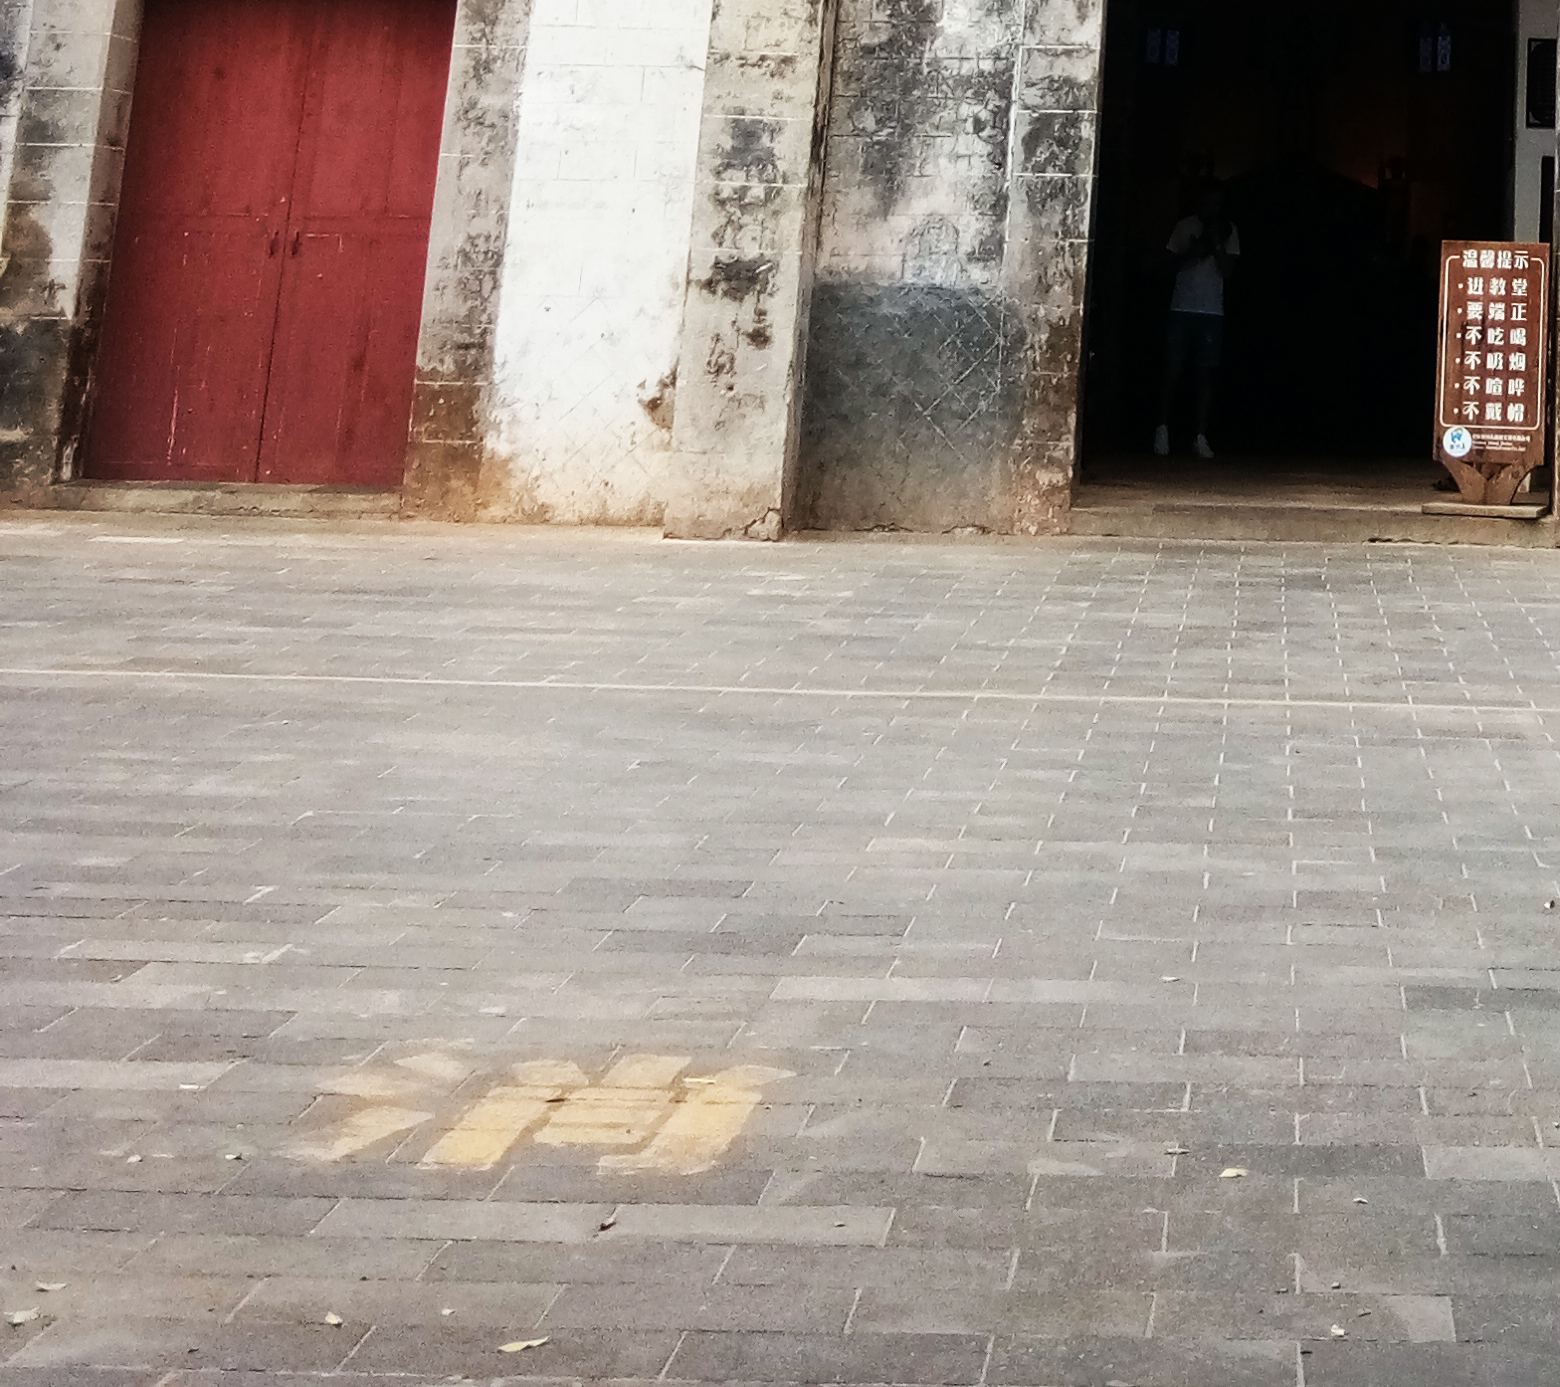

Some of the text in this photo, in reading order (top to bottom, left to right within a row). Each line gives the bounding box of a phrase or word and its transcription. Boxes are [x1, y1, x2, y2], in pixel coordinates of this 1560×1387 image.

[1462, 249, 1529, 270] 温馨提示
[1467, 276, 1528, 296] 进教堂
[1466, 301, 1528, 321] 要端正
[1465, 325, 1527, 346] 不吃喝
[1464, 350, 1527, 372] 不吸烟
[1463, 375, 1525, 397] 不喧哗
[1462, 400, 1525, 423] 不戴帽
